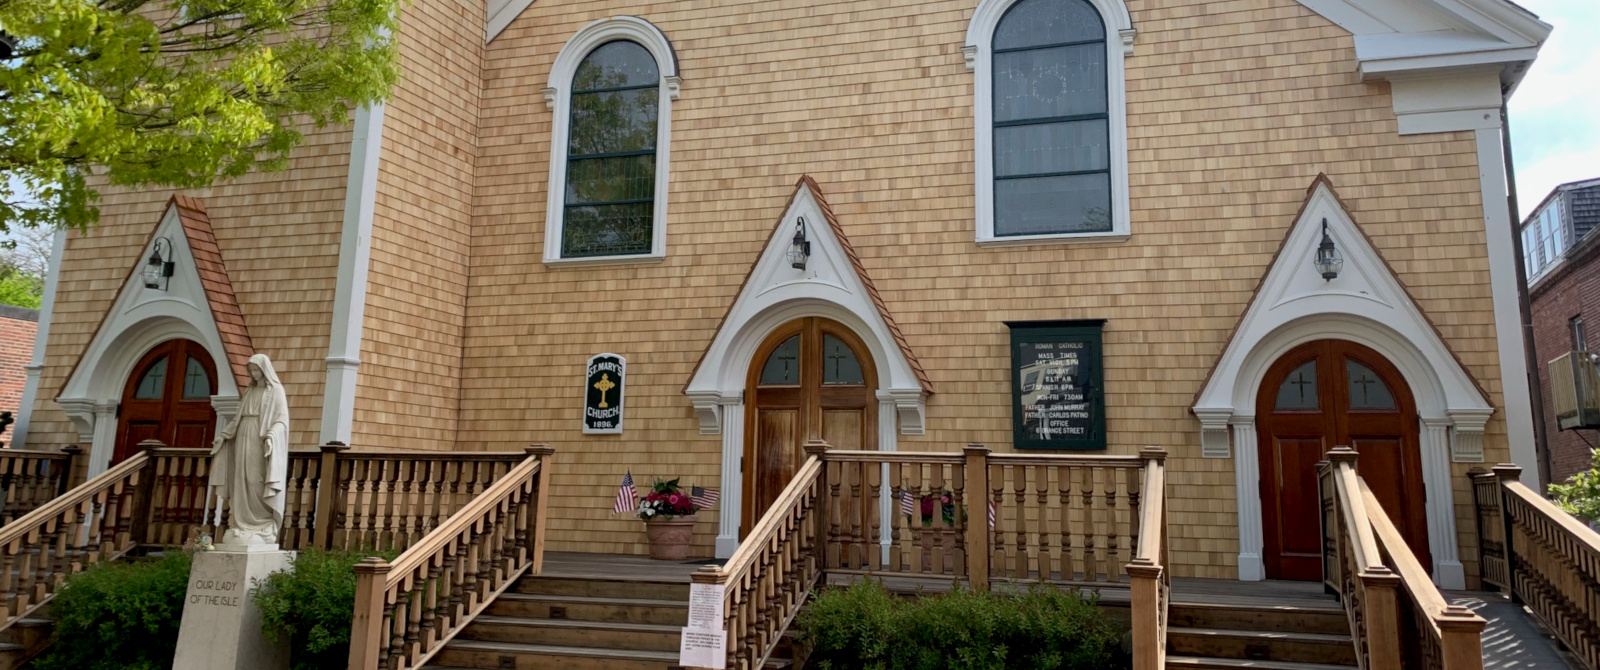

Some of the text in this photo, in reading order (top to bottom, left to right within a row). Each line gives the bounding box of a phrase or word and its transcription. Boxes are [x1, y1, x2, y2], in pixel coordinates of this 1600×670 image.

[195, 580, 238, 591] OUR LADY
[190, 594, 239, 607] OF THE ISLE
